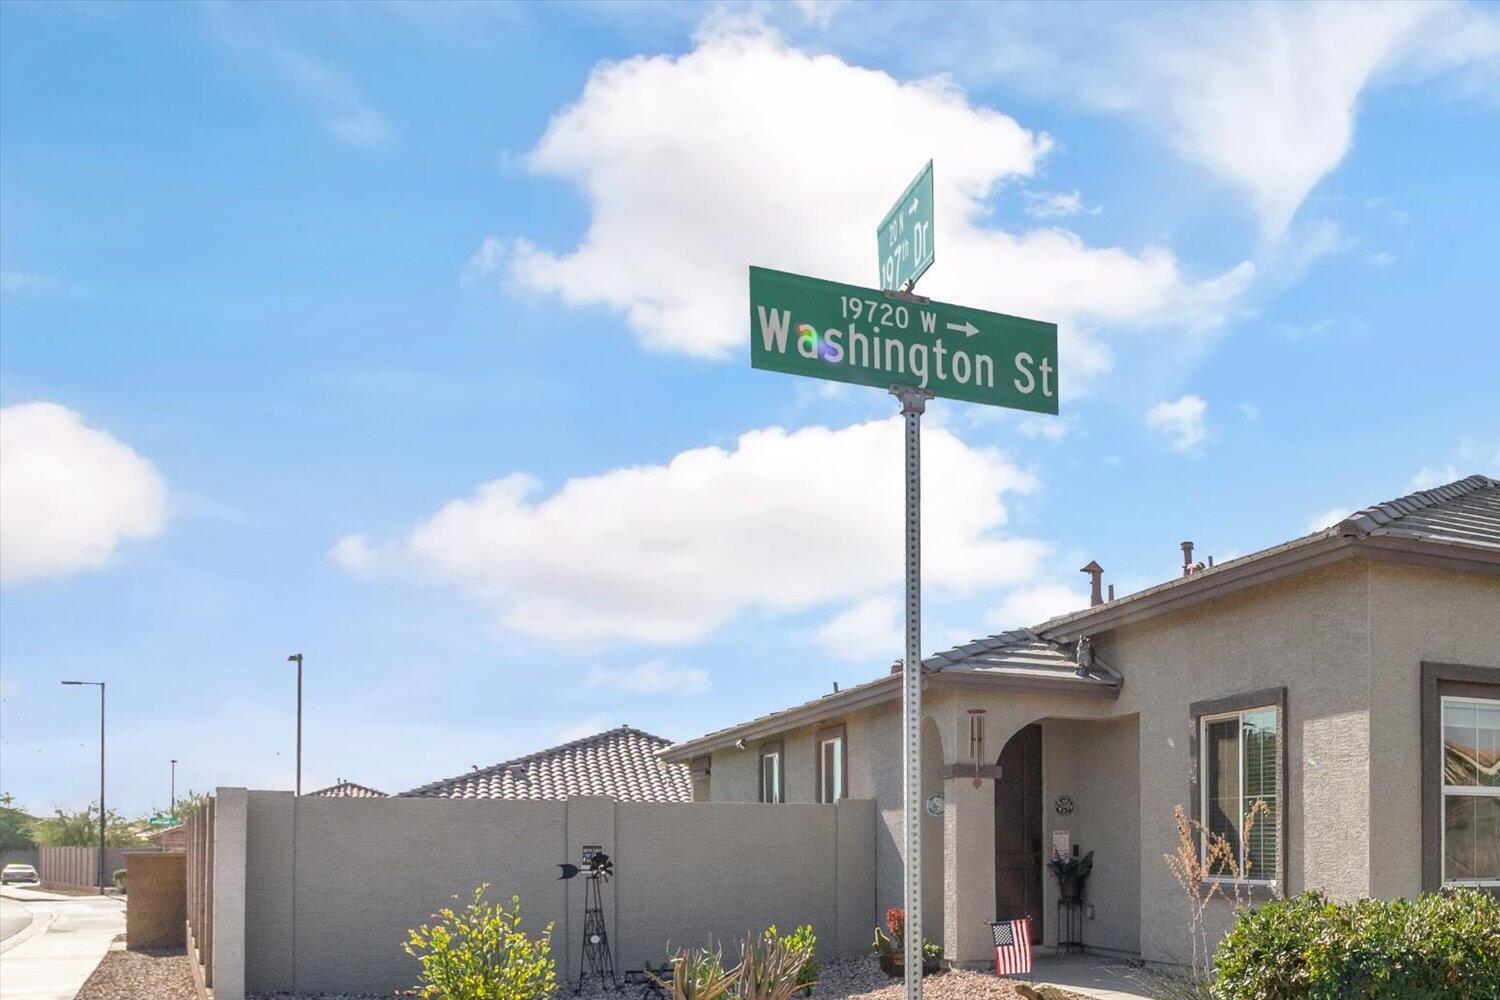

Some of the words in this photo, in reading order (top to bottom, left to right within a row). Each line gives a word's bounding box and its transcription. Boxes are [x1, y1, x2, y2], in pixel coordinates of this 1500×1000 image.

[889, 219, 897, 247] 20
[899, 210, 904, 235] N
[914, 221, 929, 268] Dr
[841, 296, 909, 330] 19720
[919, 311, 937, 334] W
[757, 305, 995, 390] Washington
[1013, 352, 1053, 397] St
